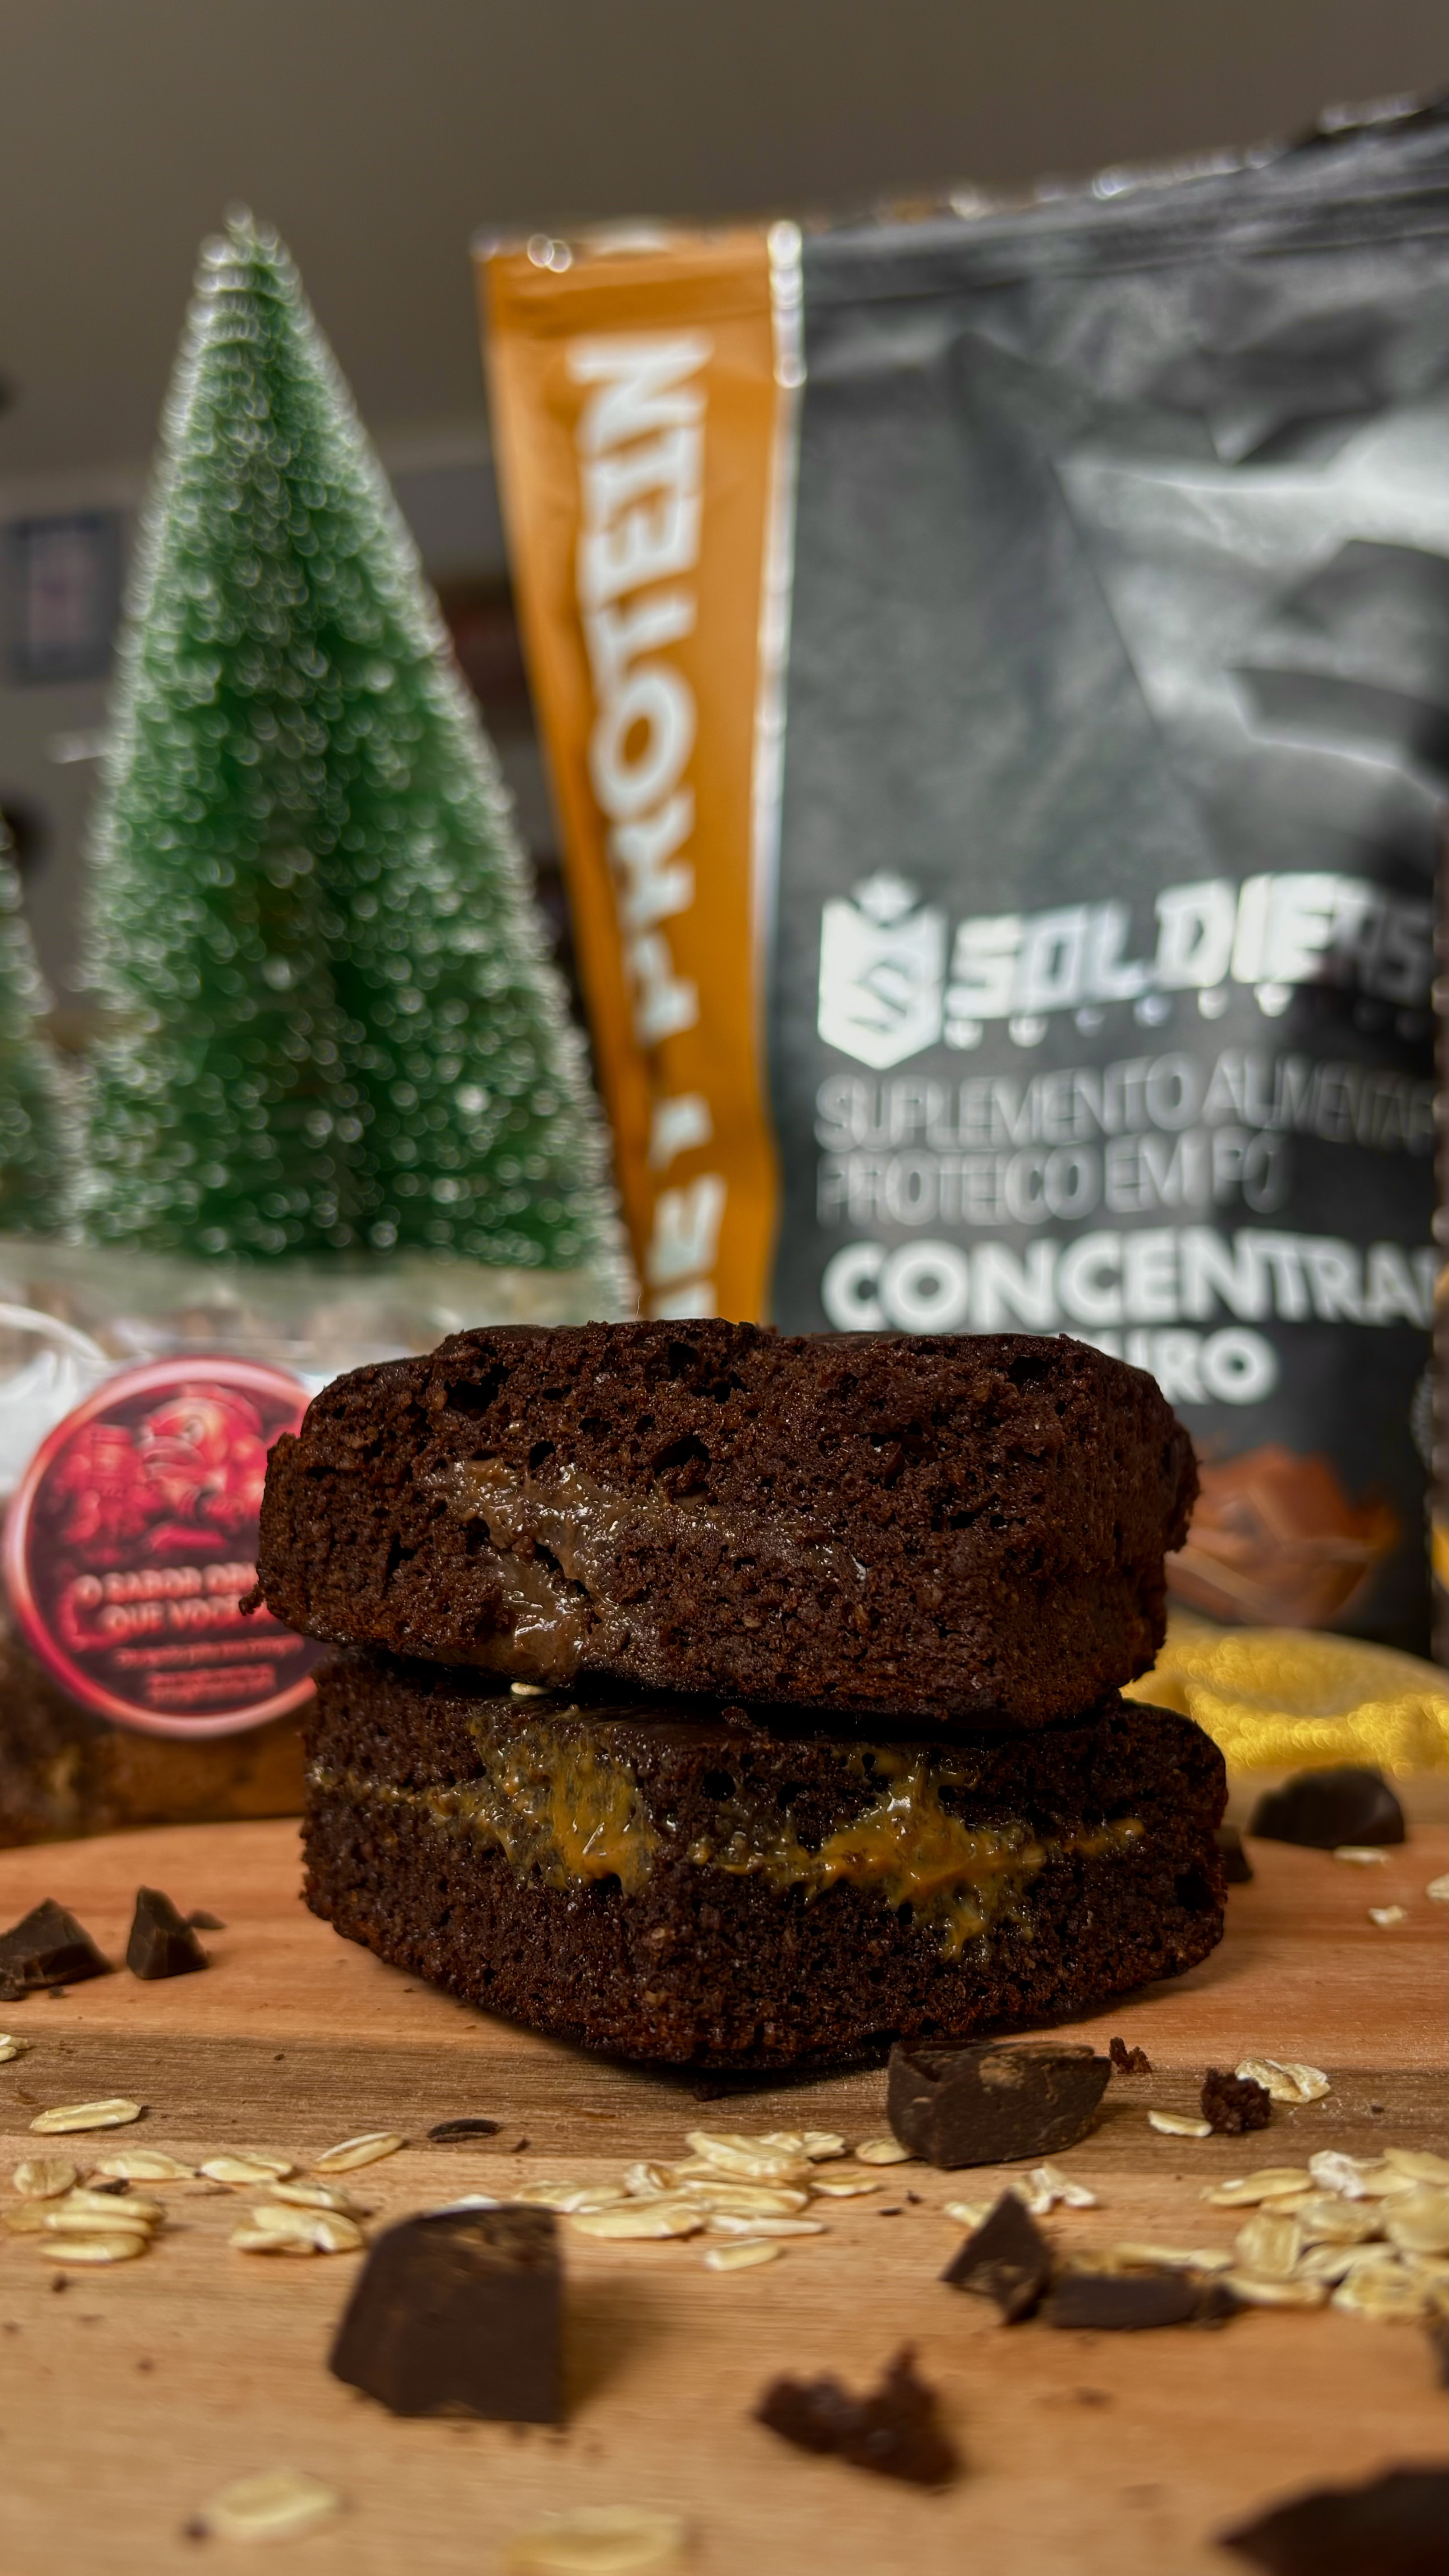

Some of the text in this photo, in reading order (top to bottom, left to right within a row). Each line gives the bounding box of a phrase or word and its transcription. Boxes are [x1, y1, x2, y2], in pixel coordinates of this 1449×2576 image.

[814, 1053, 1200, 1151] SUPLEMENTO
[1105, 1130, 1213, 1213] EM
[821, 1227, 1434, 1333] CONCENTRA
